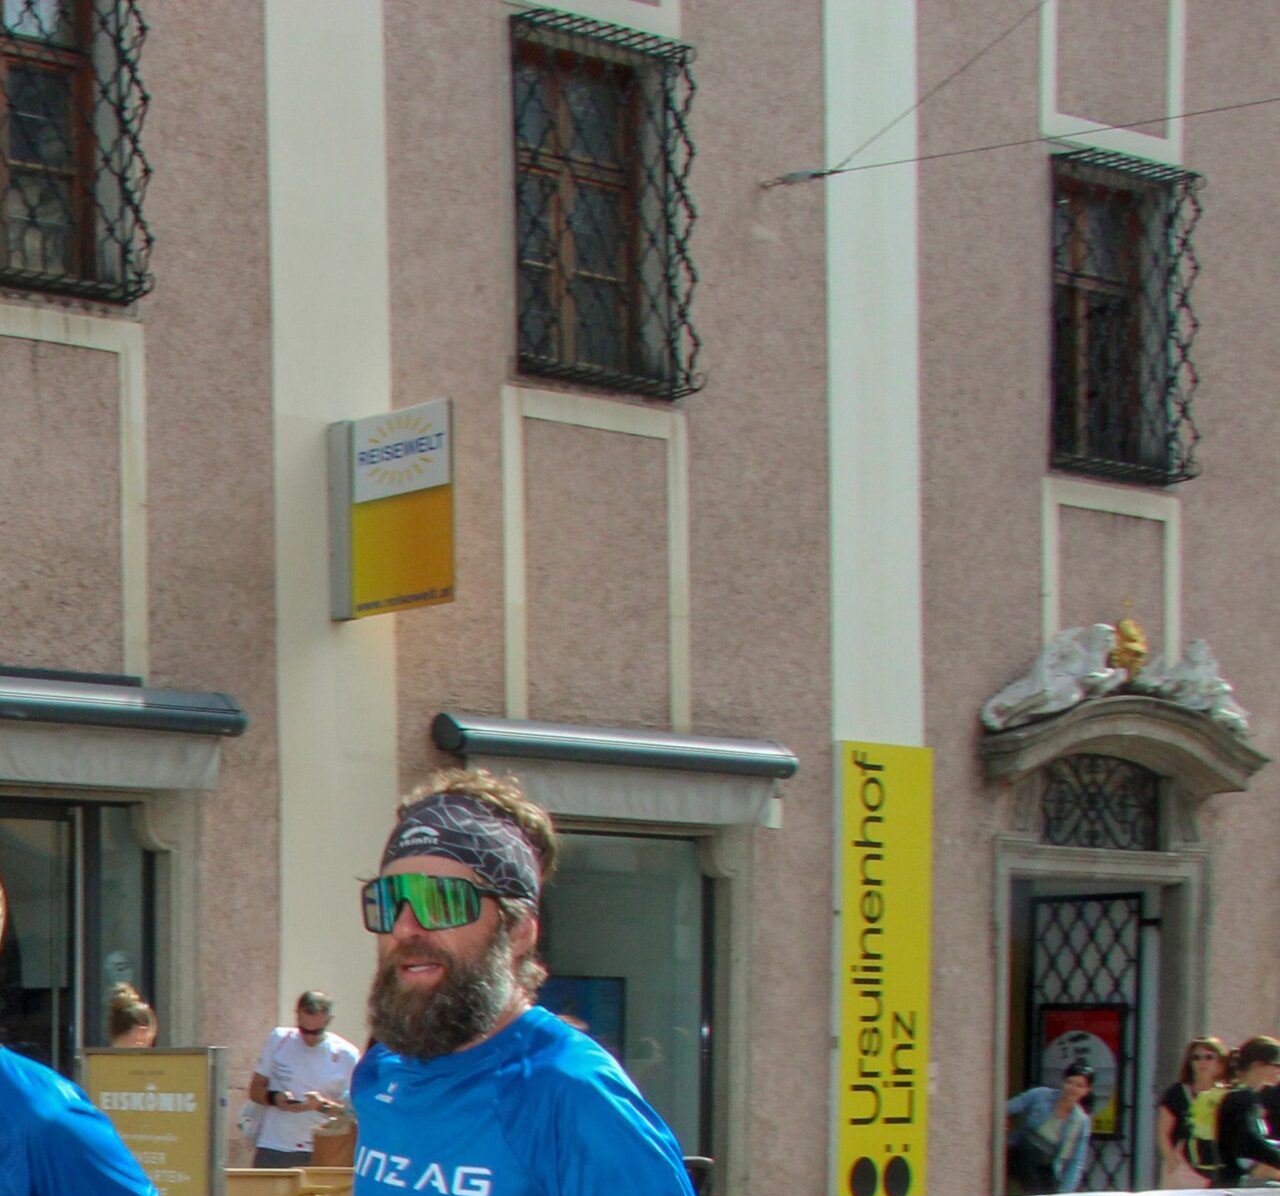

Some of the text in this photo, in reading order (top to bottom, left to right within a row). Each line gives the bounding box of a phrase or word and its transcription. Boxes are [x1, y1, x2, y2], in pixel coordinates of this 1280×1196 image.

[357, 432, 445, 466] REISEWELT
[849, 750, 884, 1126] Ursulinenhof
[883, 1010, 916, 1124] Linz
[355, 1146, 411, 1188] INZ
